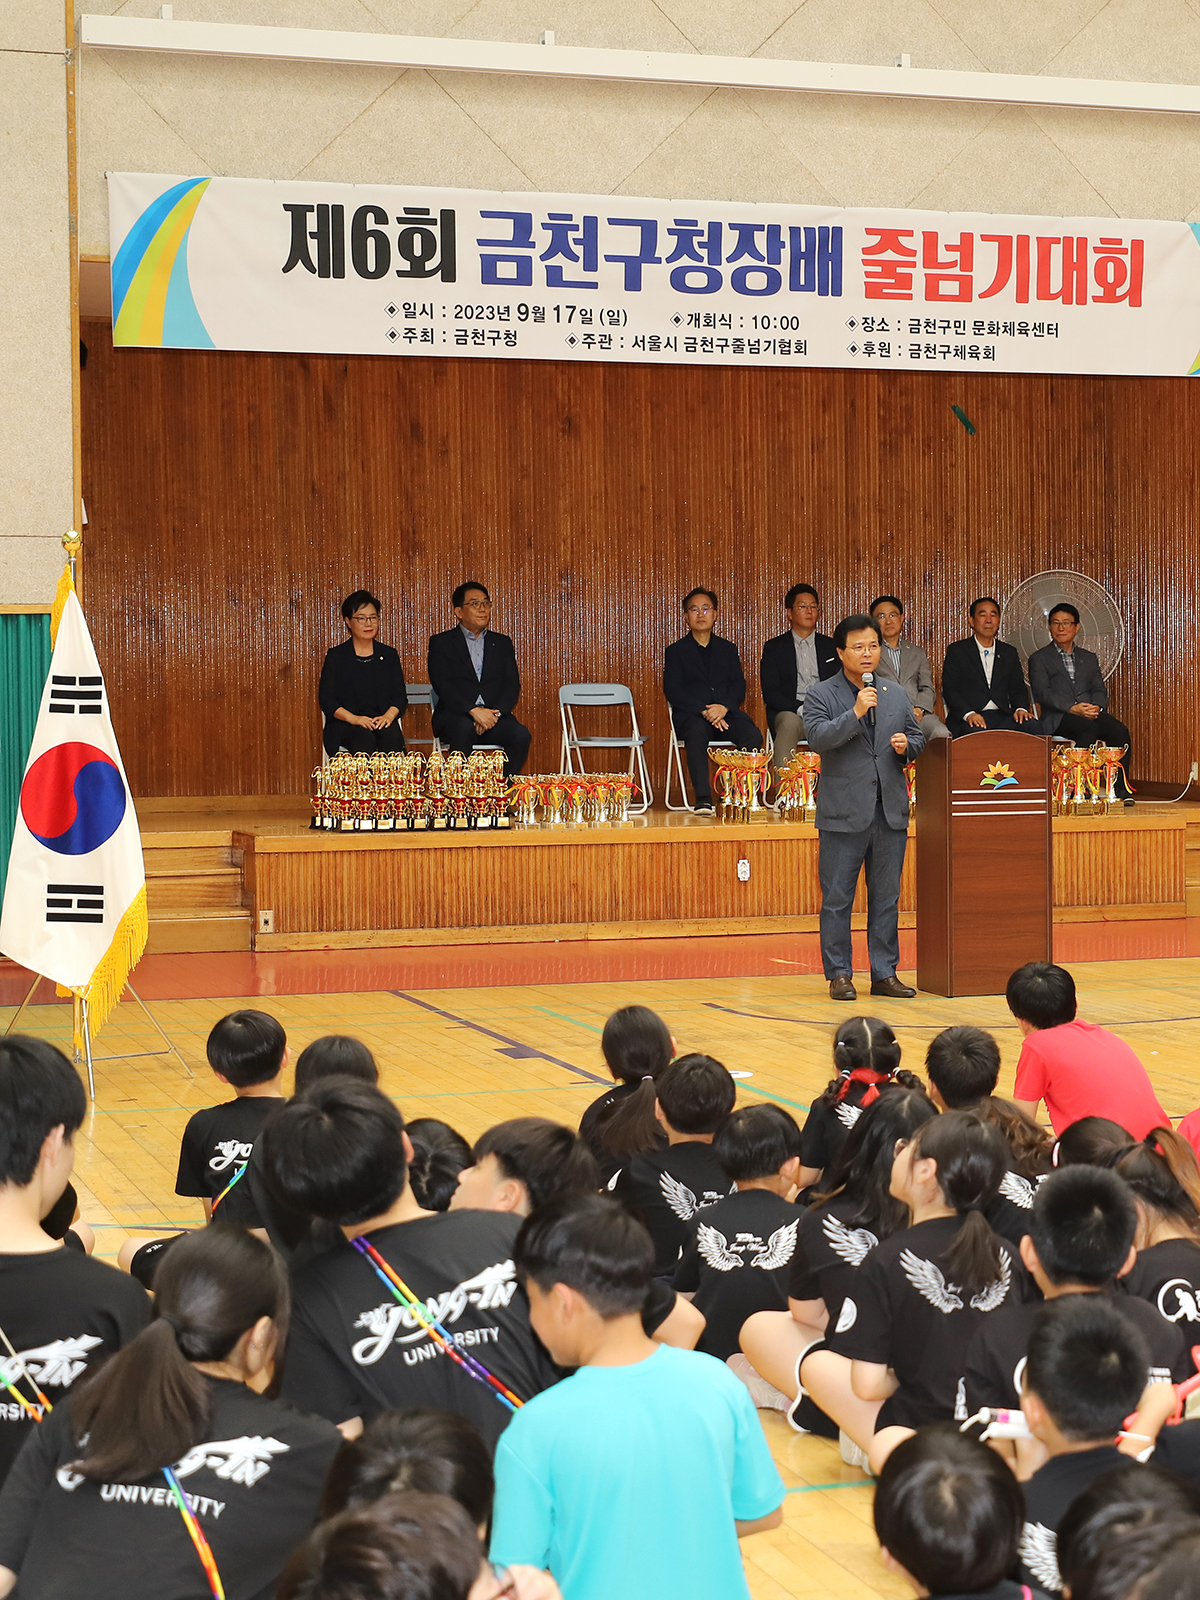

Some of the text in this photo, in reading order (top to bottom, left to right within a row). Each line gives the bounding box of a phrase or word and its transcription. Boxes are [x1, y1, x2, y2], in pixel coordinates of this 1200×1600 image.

[281, 202, 1145, 308] 제6회 금천구청장배 줄넘기대회
[402, 302, 434, 319] 일시
[454, 304, 511, 322] 2023년
[517, 302, 546, 323] 9월
[553, 304, 594, 325] 17일
[599, 308, 628, 327] (일)
[687, 312, 733, 330] 개회식
[752, 314, 800, 331] 10:00
[402, 327, 435, 345] 주최
[454, 329, 518, 348] 금천구청
[861, 316, 891, 334] 장소
[908, 318, 967, 336] 금천구민
[971, 320, 1060, 339] 문화체육센터
[581, 332, 613, 351] 주관
[631, 334, 678, 353] 서울시
[683, 336, 808, 356] 금천구줄넘기협회
[862, 341, 892, 358] 후원
[908, 343, 996, 362] 금천구체육회
